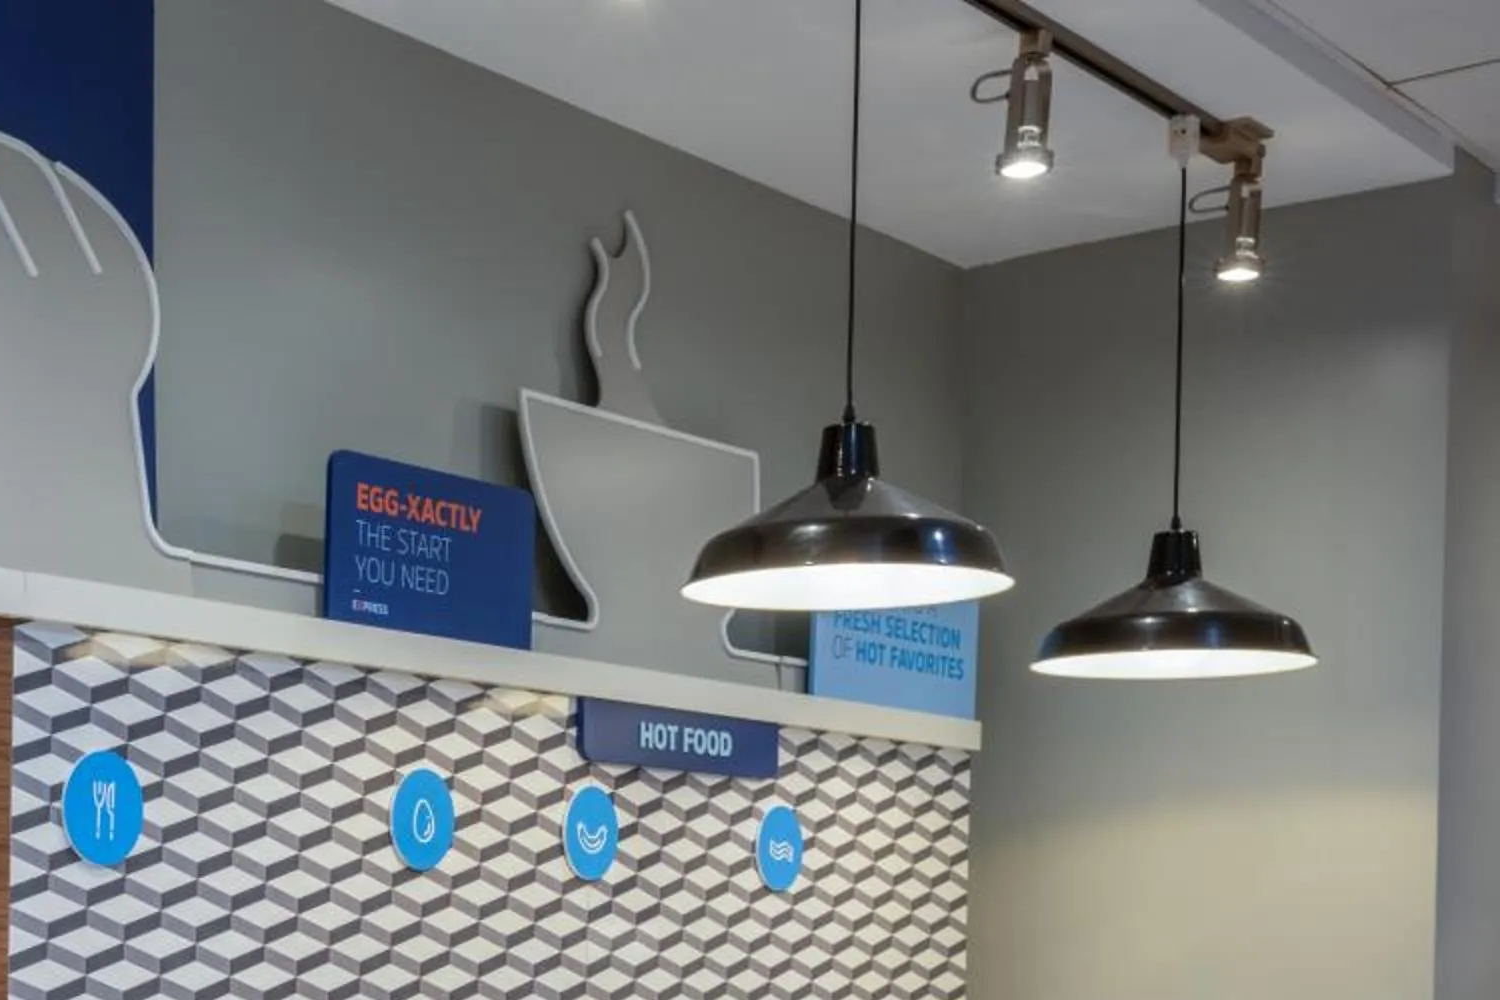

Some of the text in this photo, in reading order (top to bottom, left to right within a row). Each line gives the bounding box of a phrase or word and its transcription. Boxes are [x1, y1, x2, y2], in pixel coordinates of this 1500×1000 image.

[356, 482, 483, 533] EGG-XACTLY
[356, 519, 452, 562] THE START
[355, 555, 450, 596] YOU NEED
[885, 614, 962, 650] SELECTION
[856, 639, 888, 666] HOT
[890, 645, 964, 682] FAVORITES
[640, 720, 733, 757] HOT FOOD
